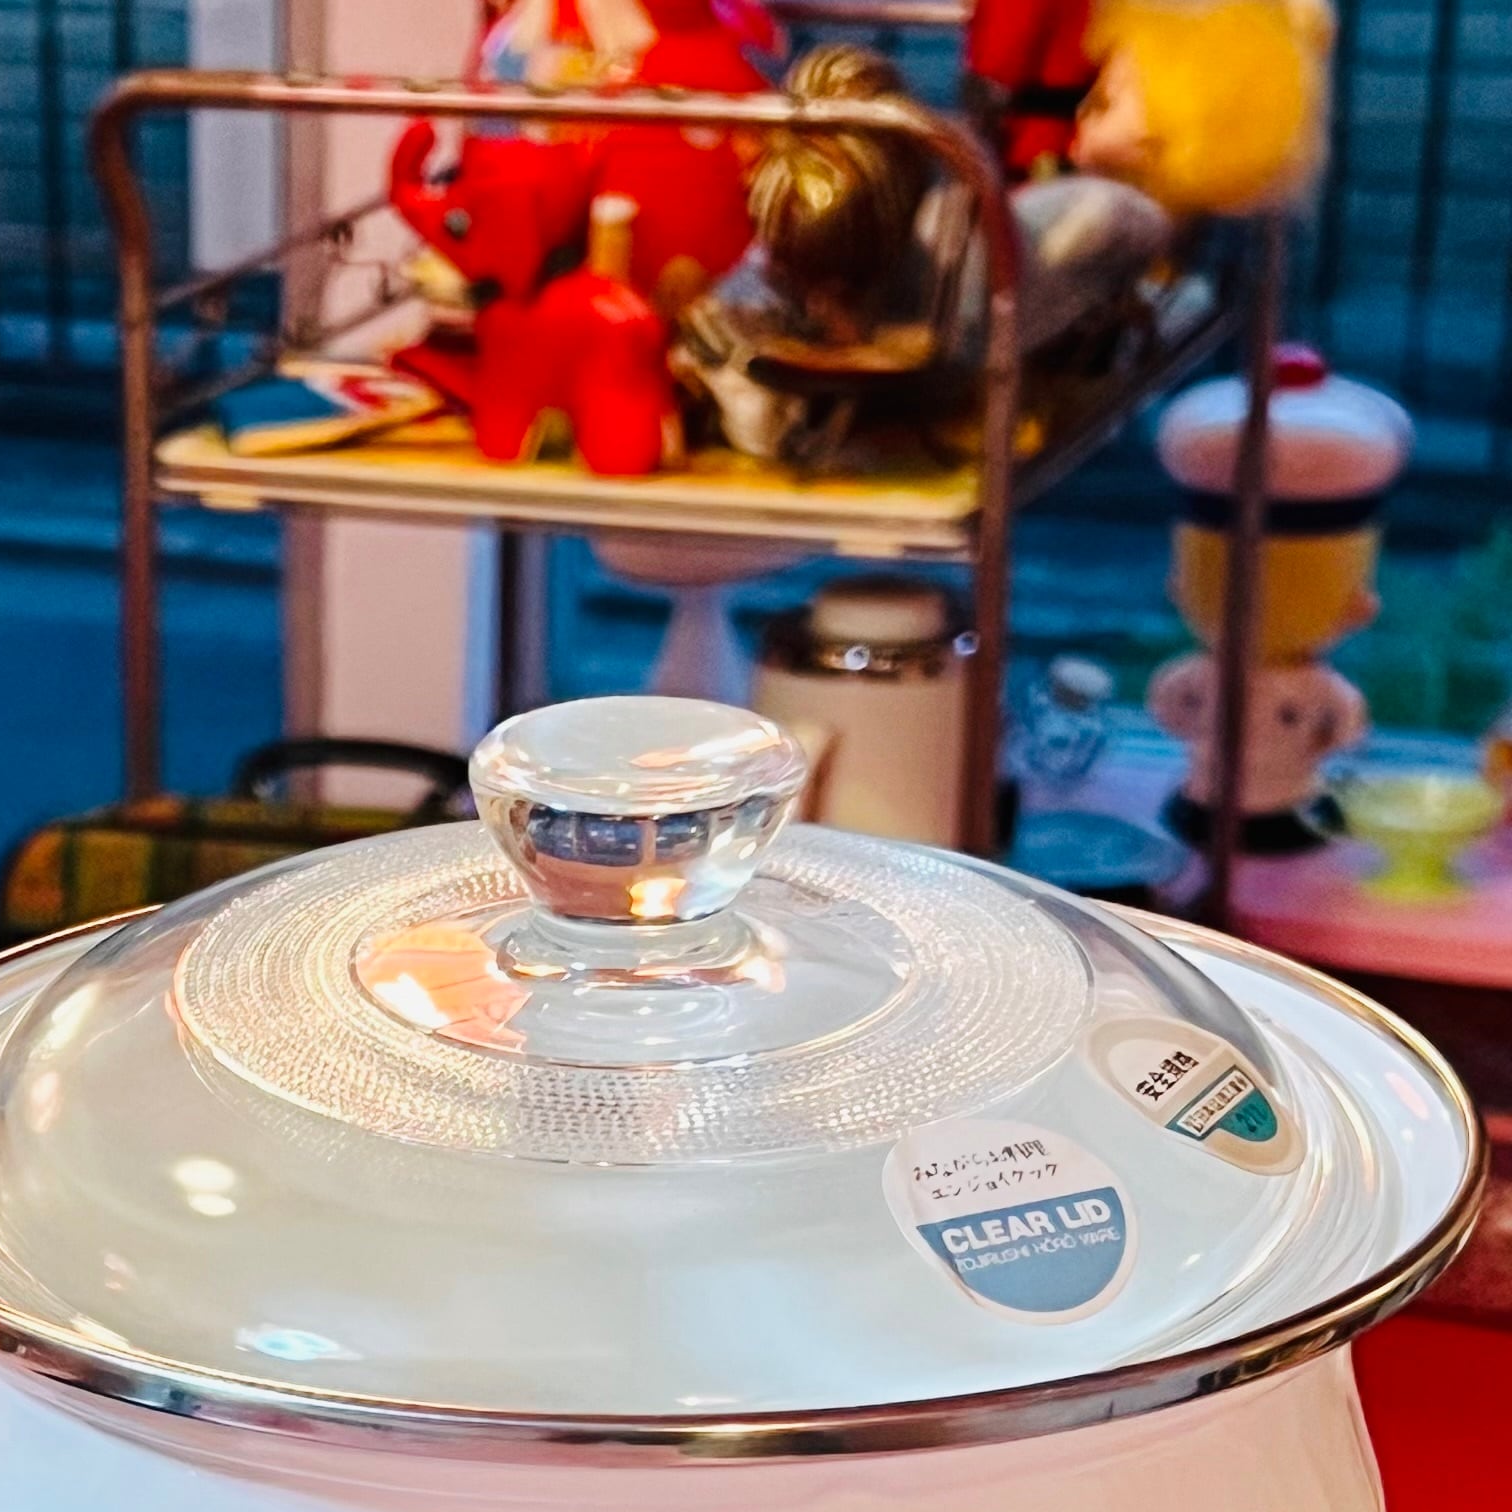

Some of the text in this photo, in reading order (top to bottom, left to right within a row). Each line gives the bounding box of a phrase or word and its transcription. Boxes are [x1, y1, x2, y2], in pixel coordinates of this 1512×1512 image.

[932, 1164, 1058, 1199] エンジョイクック
[942, 1198, 1111, 1254] CLEAR LID
